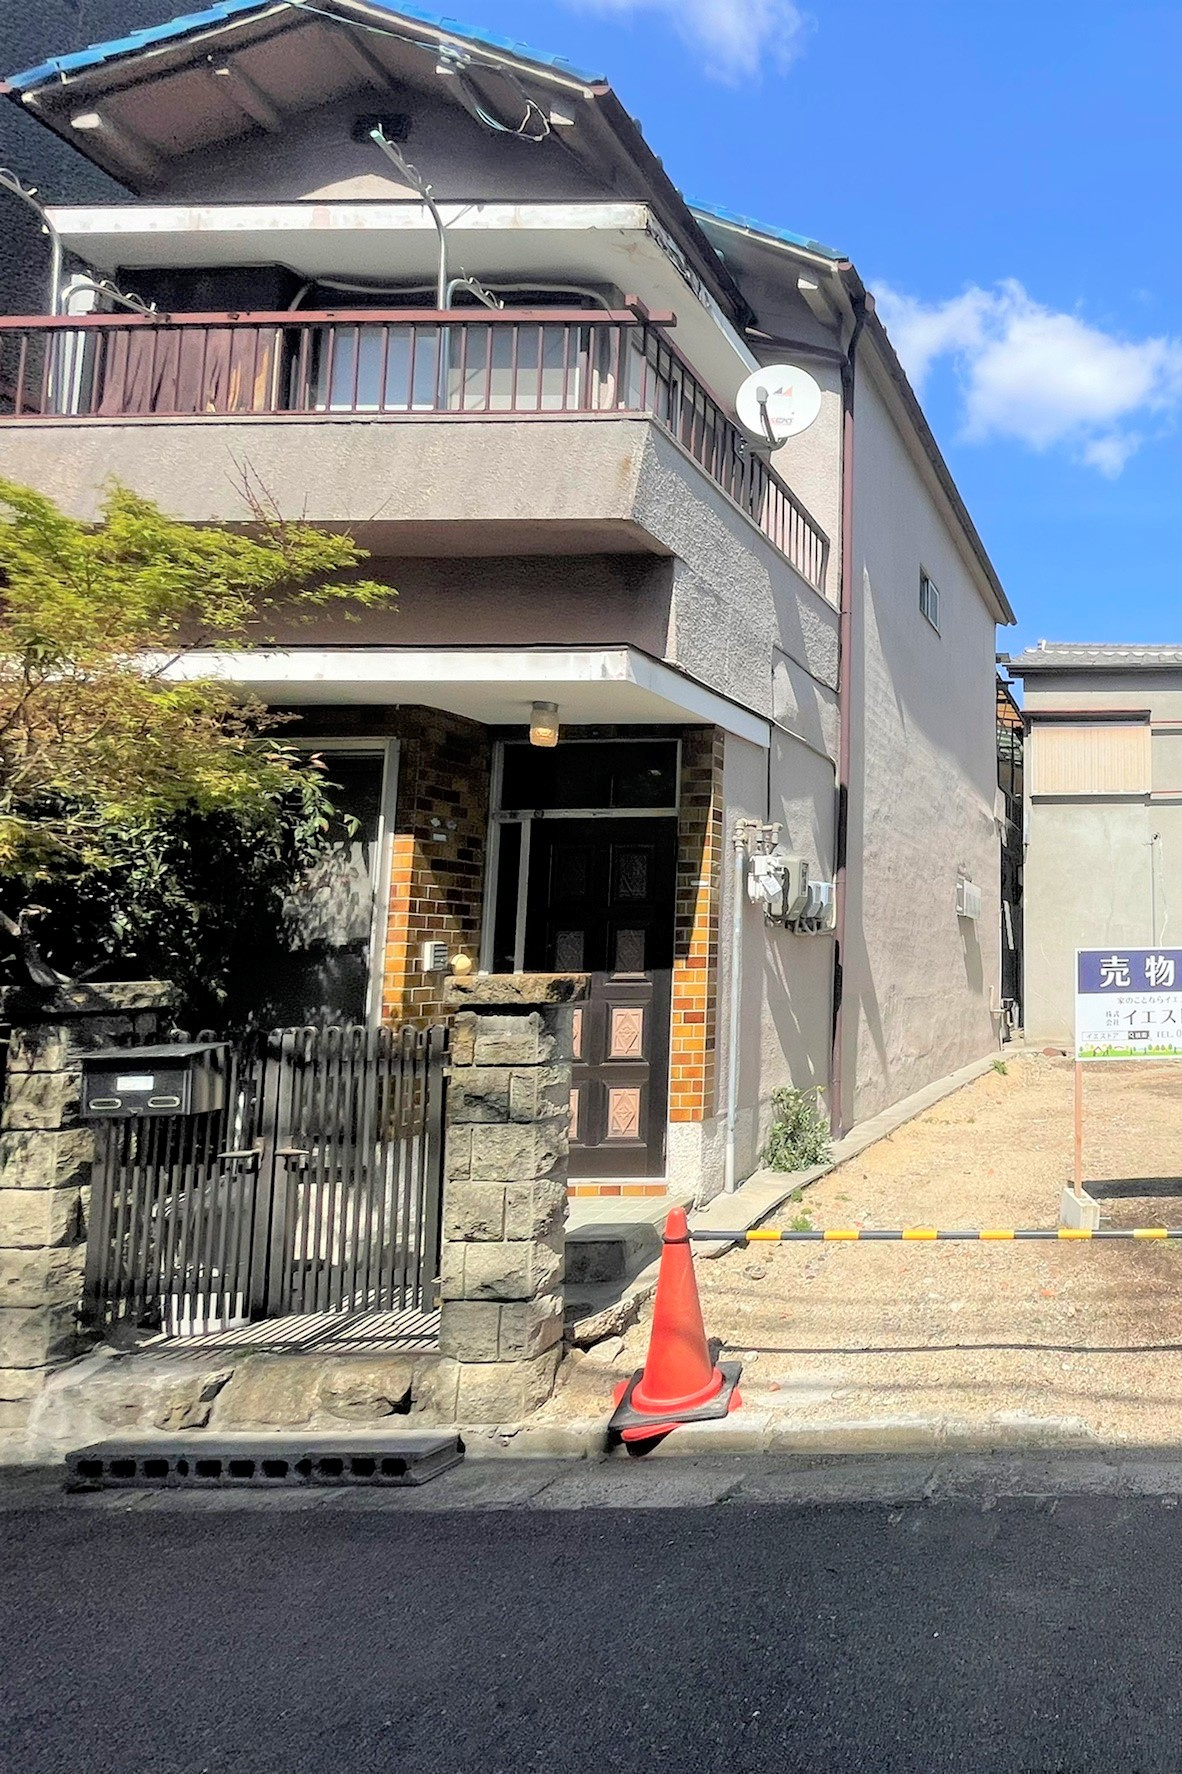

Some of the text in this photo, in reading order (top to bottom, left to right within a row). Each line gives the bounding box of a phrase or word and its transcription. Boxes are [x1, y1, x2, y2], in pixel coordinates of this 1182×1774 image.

[1086, 1032, 1119, 1040] イエストア
